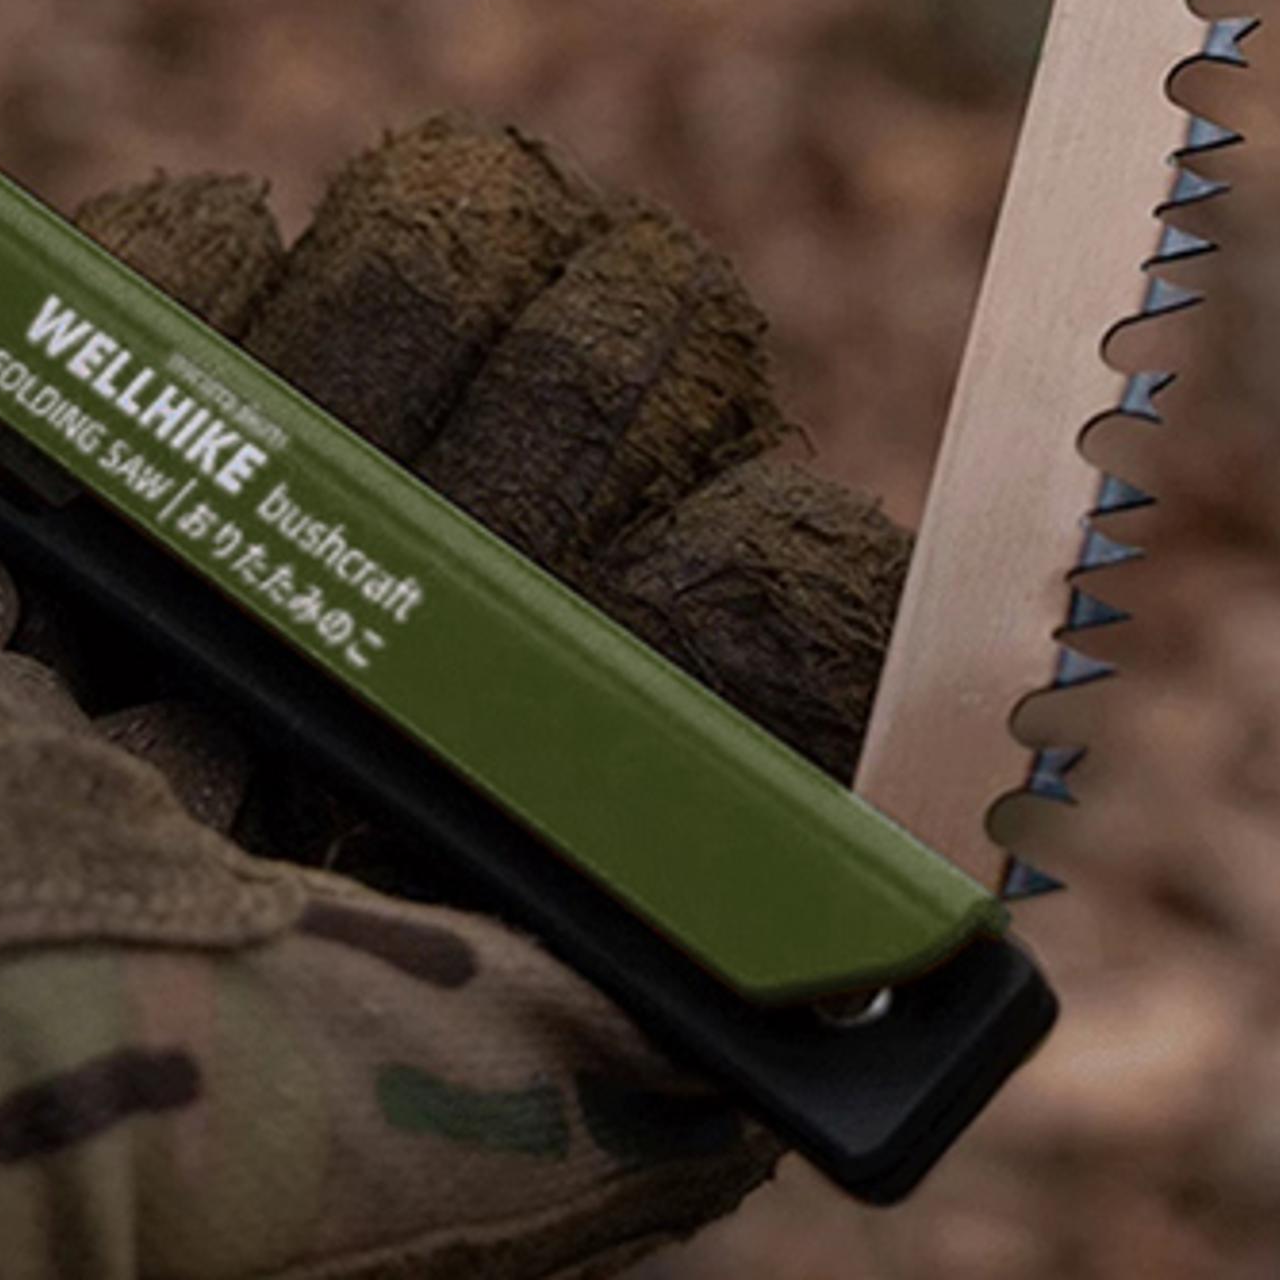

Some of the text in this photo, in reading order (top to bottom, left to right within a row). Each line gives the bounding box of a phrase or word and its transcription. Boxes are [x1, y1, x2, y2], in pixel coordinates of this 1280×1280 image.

[26, 294, 268, 496] WELLHIKE
[257, 481, 424, 623] bushcraft
[97, 438, 176, 501] SAW
